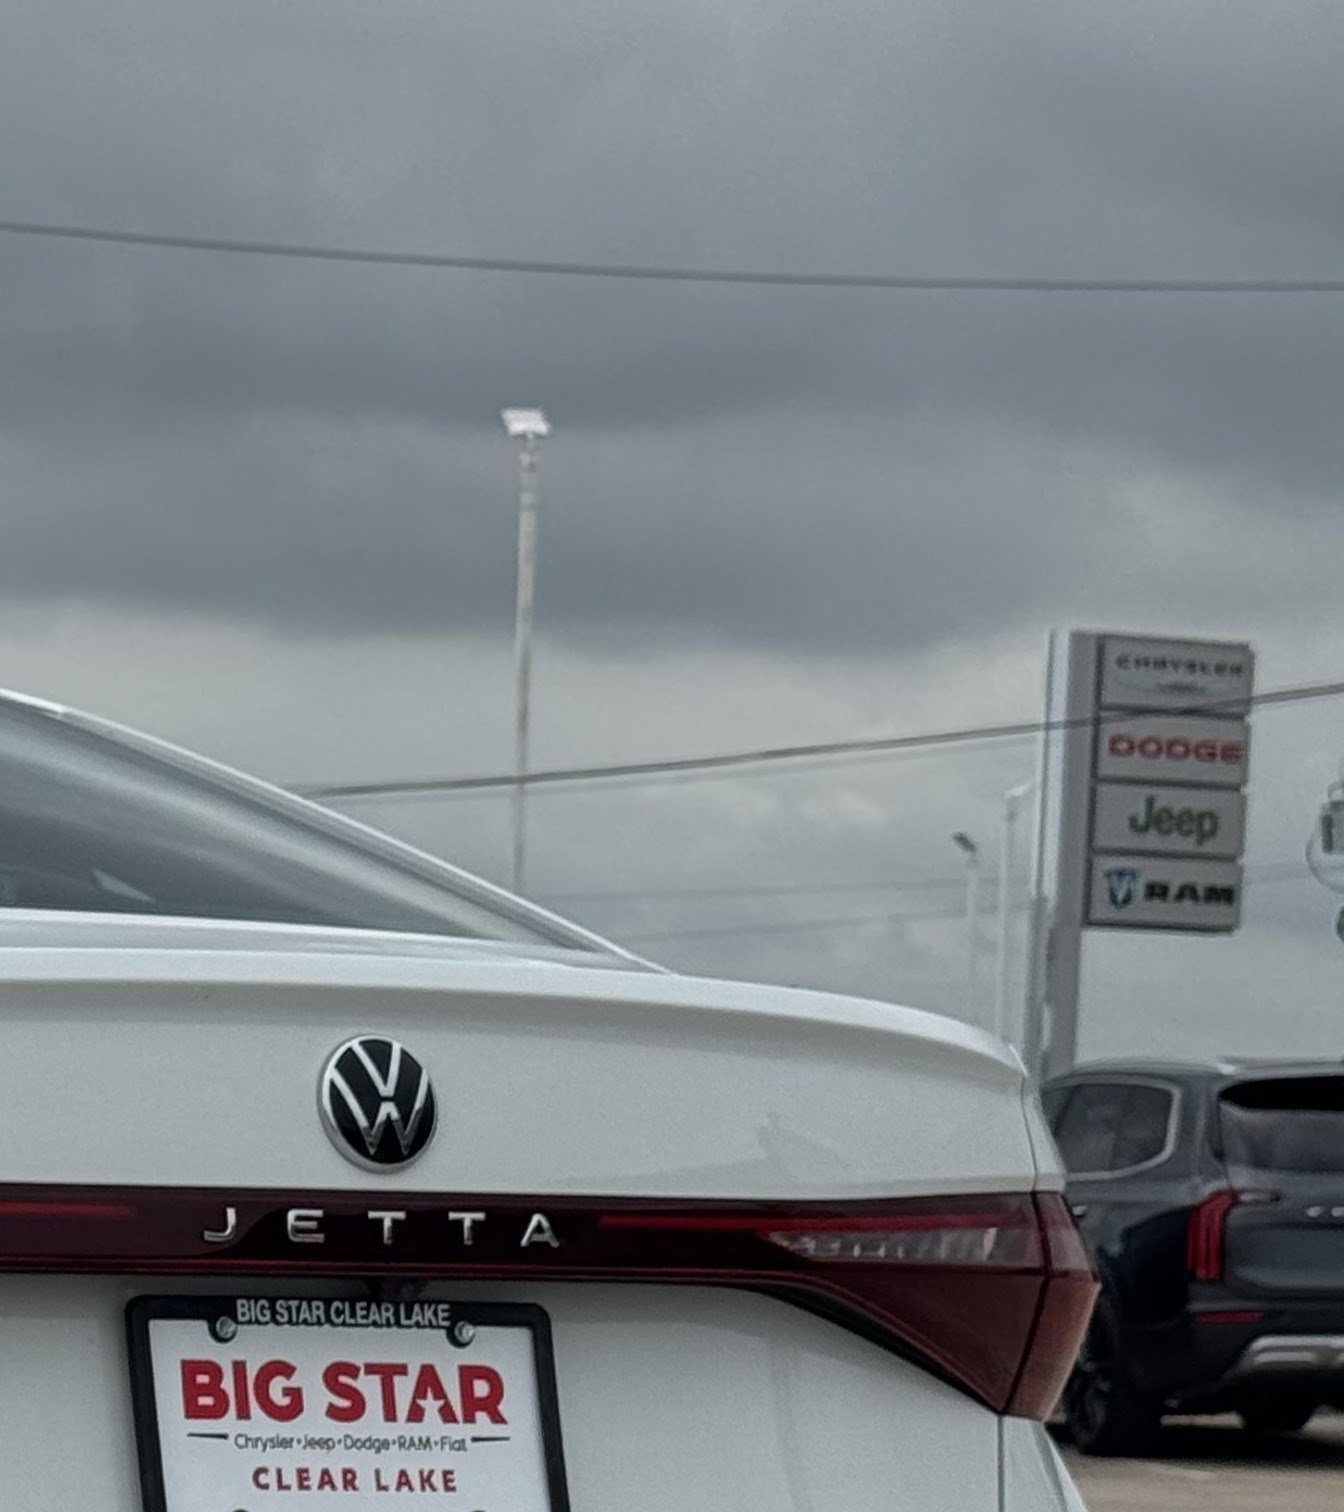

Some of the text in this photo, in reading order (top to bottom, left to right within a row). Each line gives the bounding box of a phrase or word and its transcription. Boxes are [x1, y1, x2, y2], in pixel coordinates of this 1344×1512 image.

[1109, 734, 1243, 765] DODGE
[1128, 795, 1219, 846] Jeep
[1144, 880, 1235, 906] RAM
[203, 1207, 560, 1249] JETTA
[236, 1299, 451, 1327] BIG STAR CLEAR LAKE
[179, 1359, 508, 1425] BIG STAR
[252, 1466, 457, 1493] CLEAR LAKE
